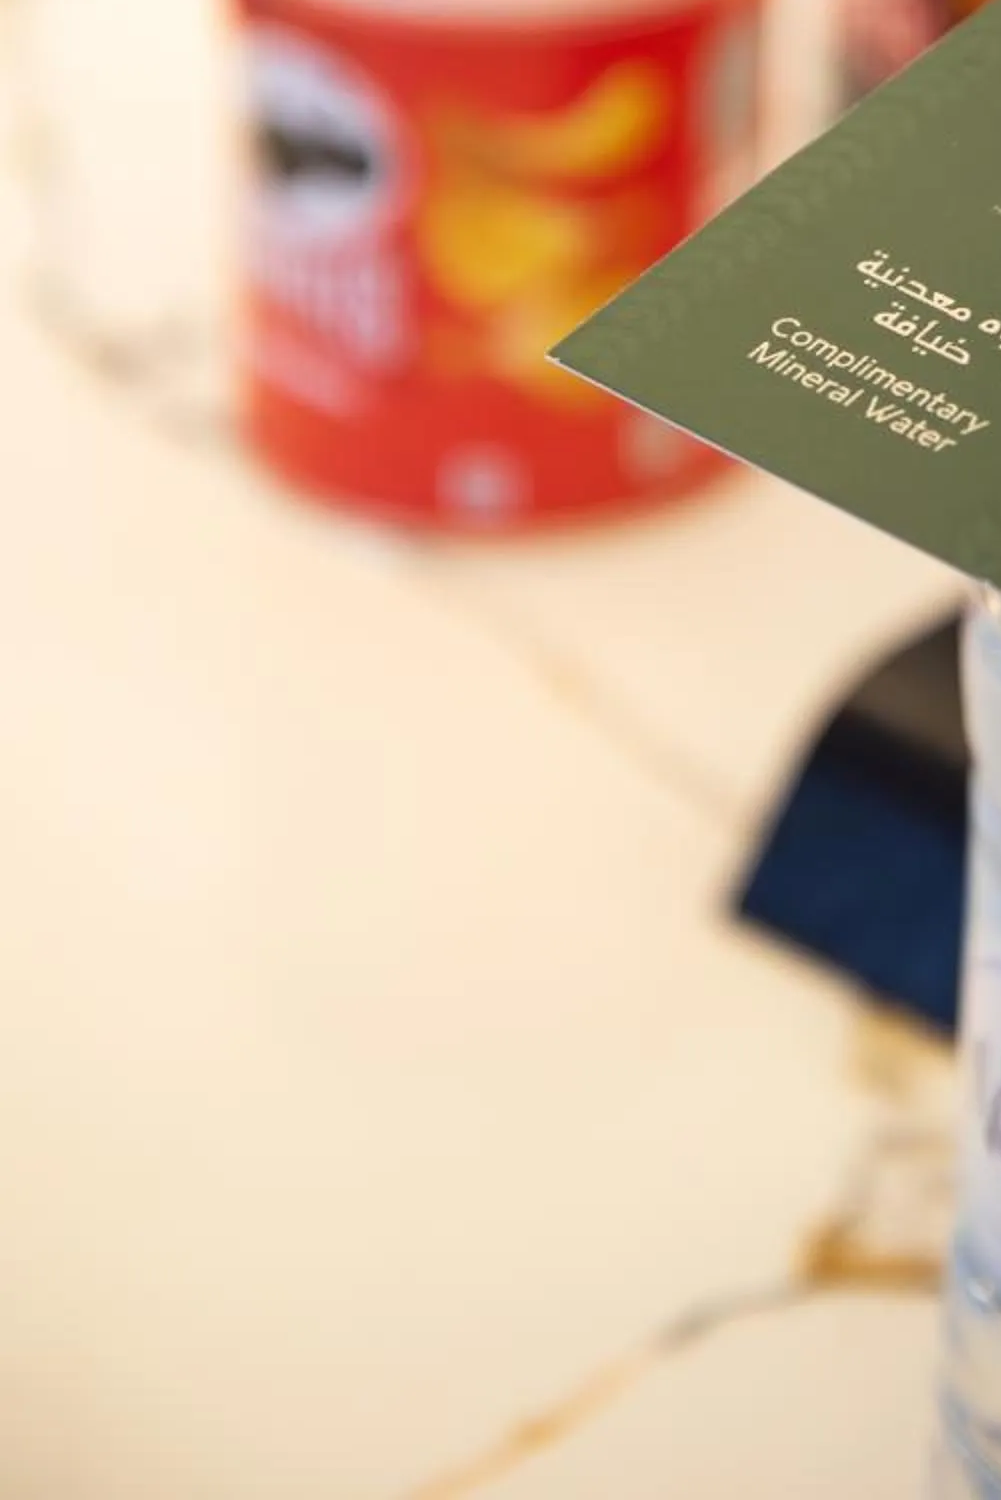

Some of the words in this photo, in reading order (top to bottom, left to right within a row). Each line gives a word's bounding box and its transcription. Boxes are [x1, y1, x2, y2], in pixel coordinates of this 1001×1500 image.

[857, 250, 972, 322] معدنية
[771, 317, 990, 435] Complimentary
[873, 301, 971, 365] ضيافة
[747, 341, 865, 407] Mineral
[864, 396, 958, 452] Water
